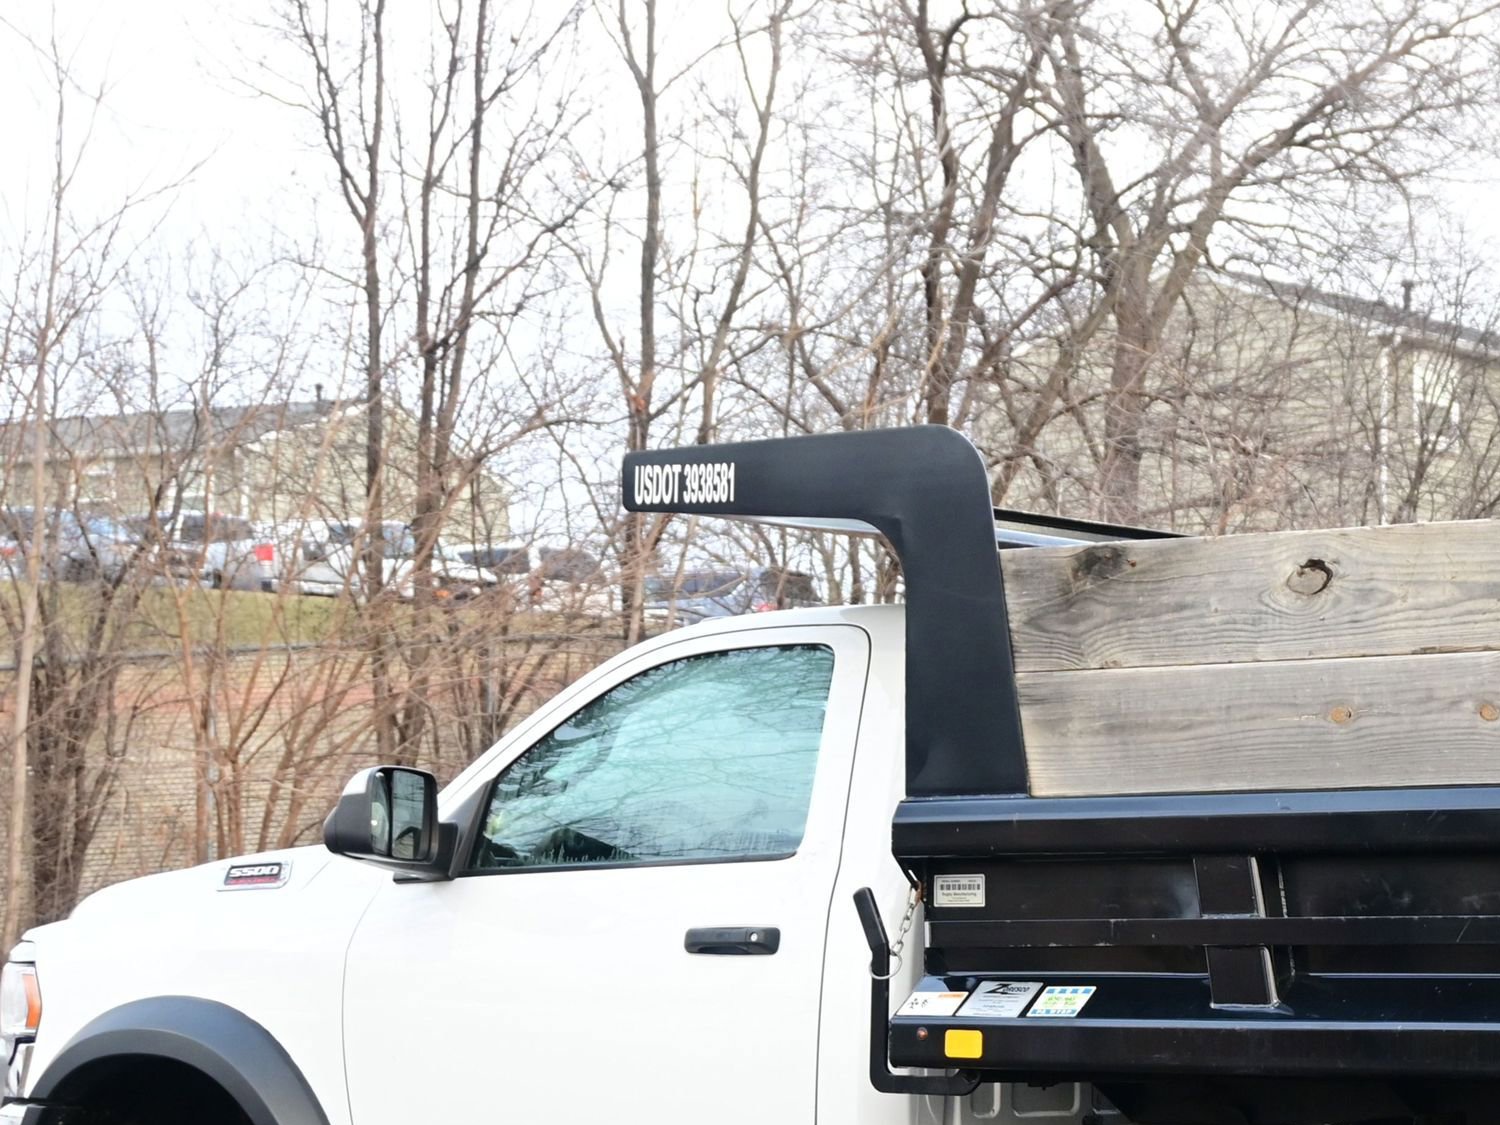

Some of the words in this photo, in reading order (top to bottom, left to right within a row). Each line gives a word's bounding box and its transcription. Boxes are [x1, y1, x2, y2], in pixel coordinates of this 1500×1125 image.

[634, 463, 682, 505] USDOT
[683, 462, 736, 504] 3938581
[229, 865, 279, 877] 5500
